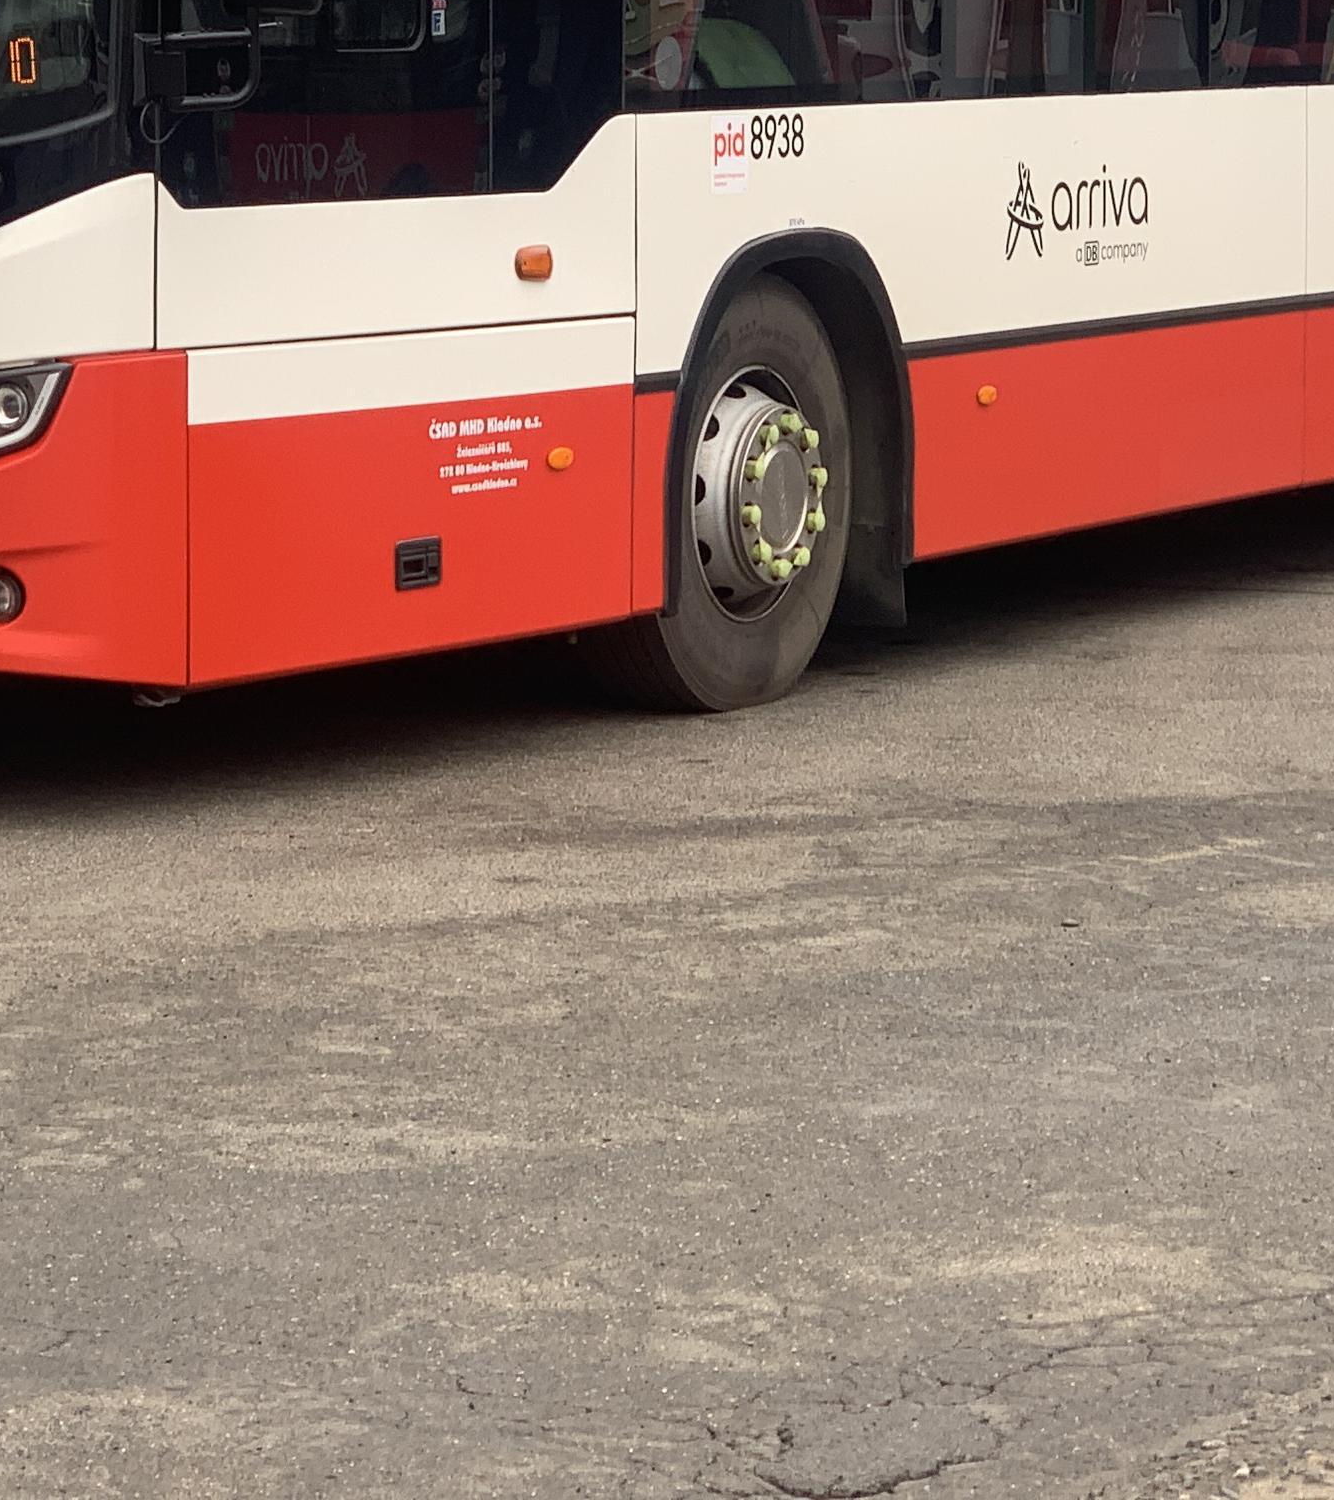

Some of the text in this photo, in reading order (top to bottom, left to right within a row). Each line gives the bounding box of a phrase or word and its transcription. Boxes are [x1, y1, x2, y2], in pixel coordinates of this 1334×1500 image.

[714, 122, 745, 166] pid
[750, 113, 804, 160] 8938
[1051, 164, 1148, 232] arriva
[1075, 241, 1148, 264] a DB company
[428, 415, 543, 440] ČSAD MHD Kladno a.s.
[451, 478, 518, 495] www.csadkladno.cz
